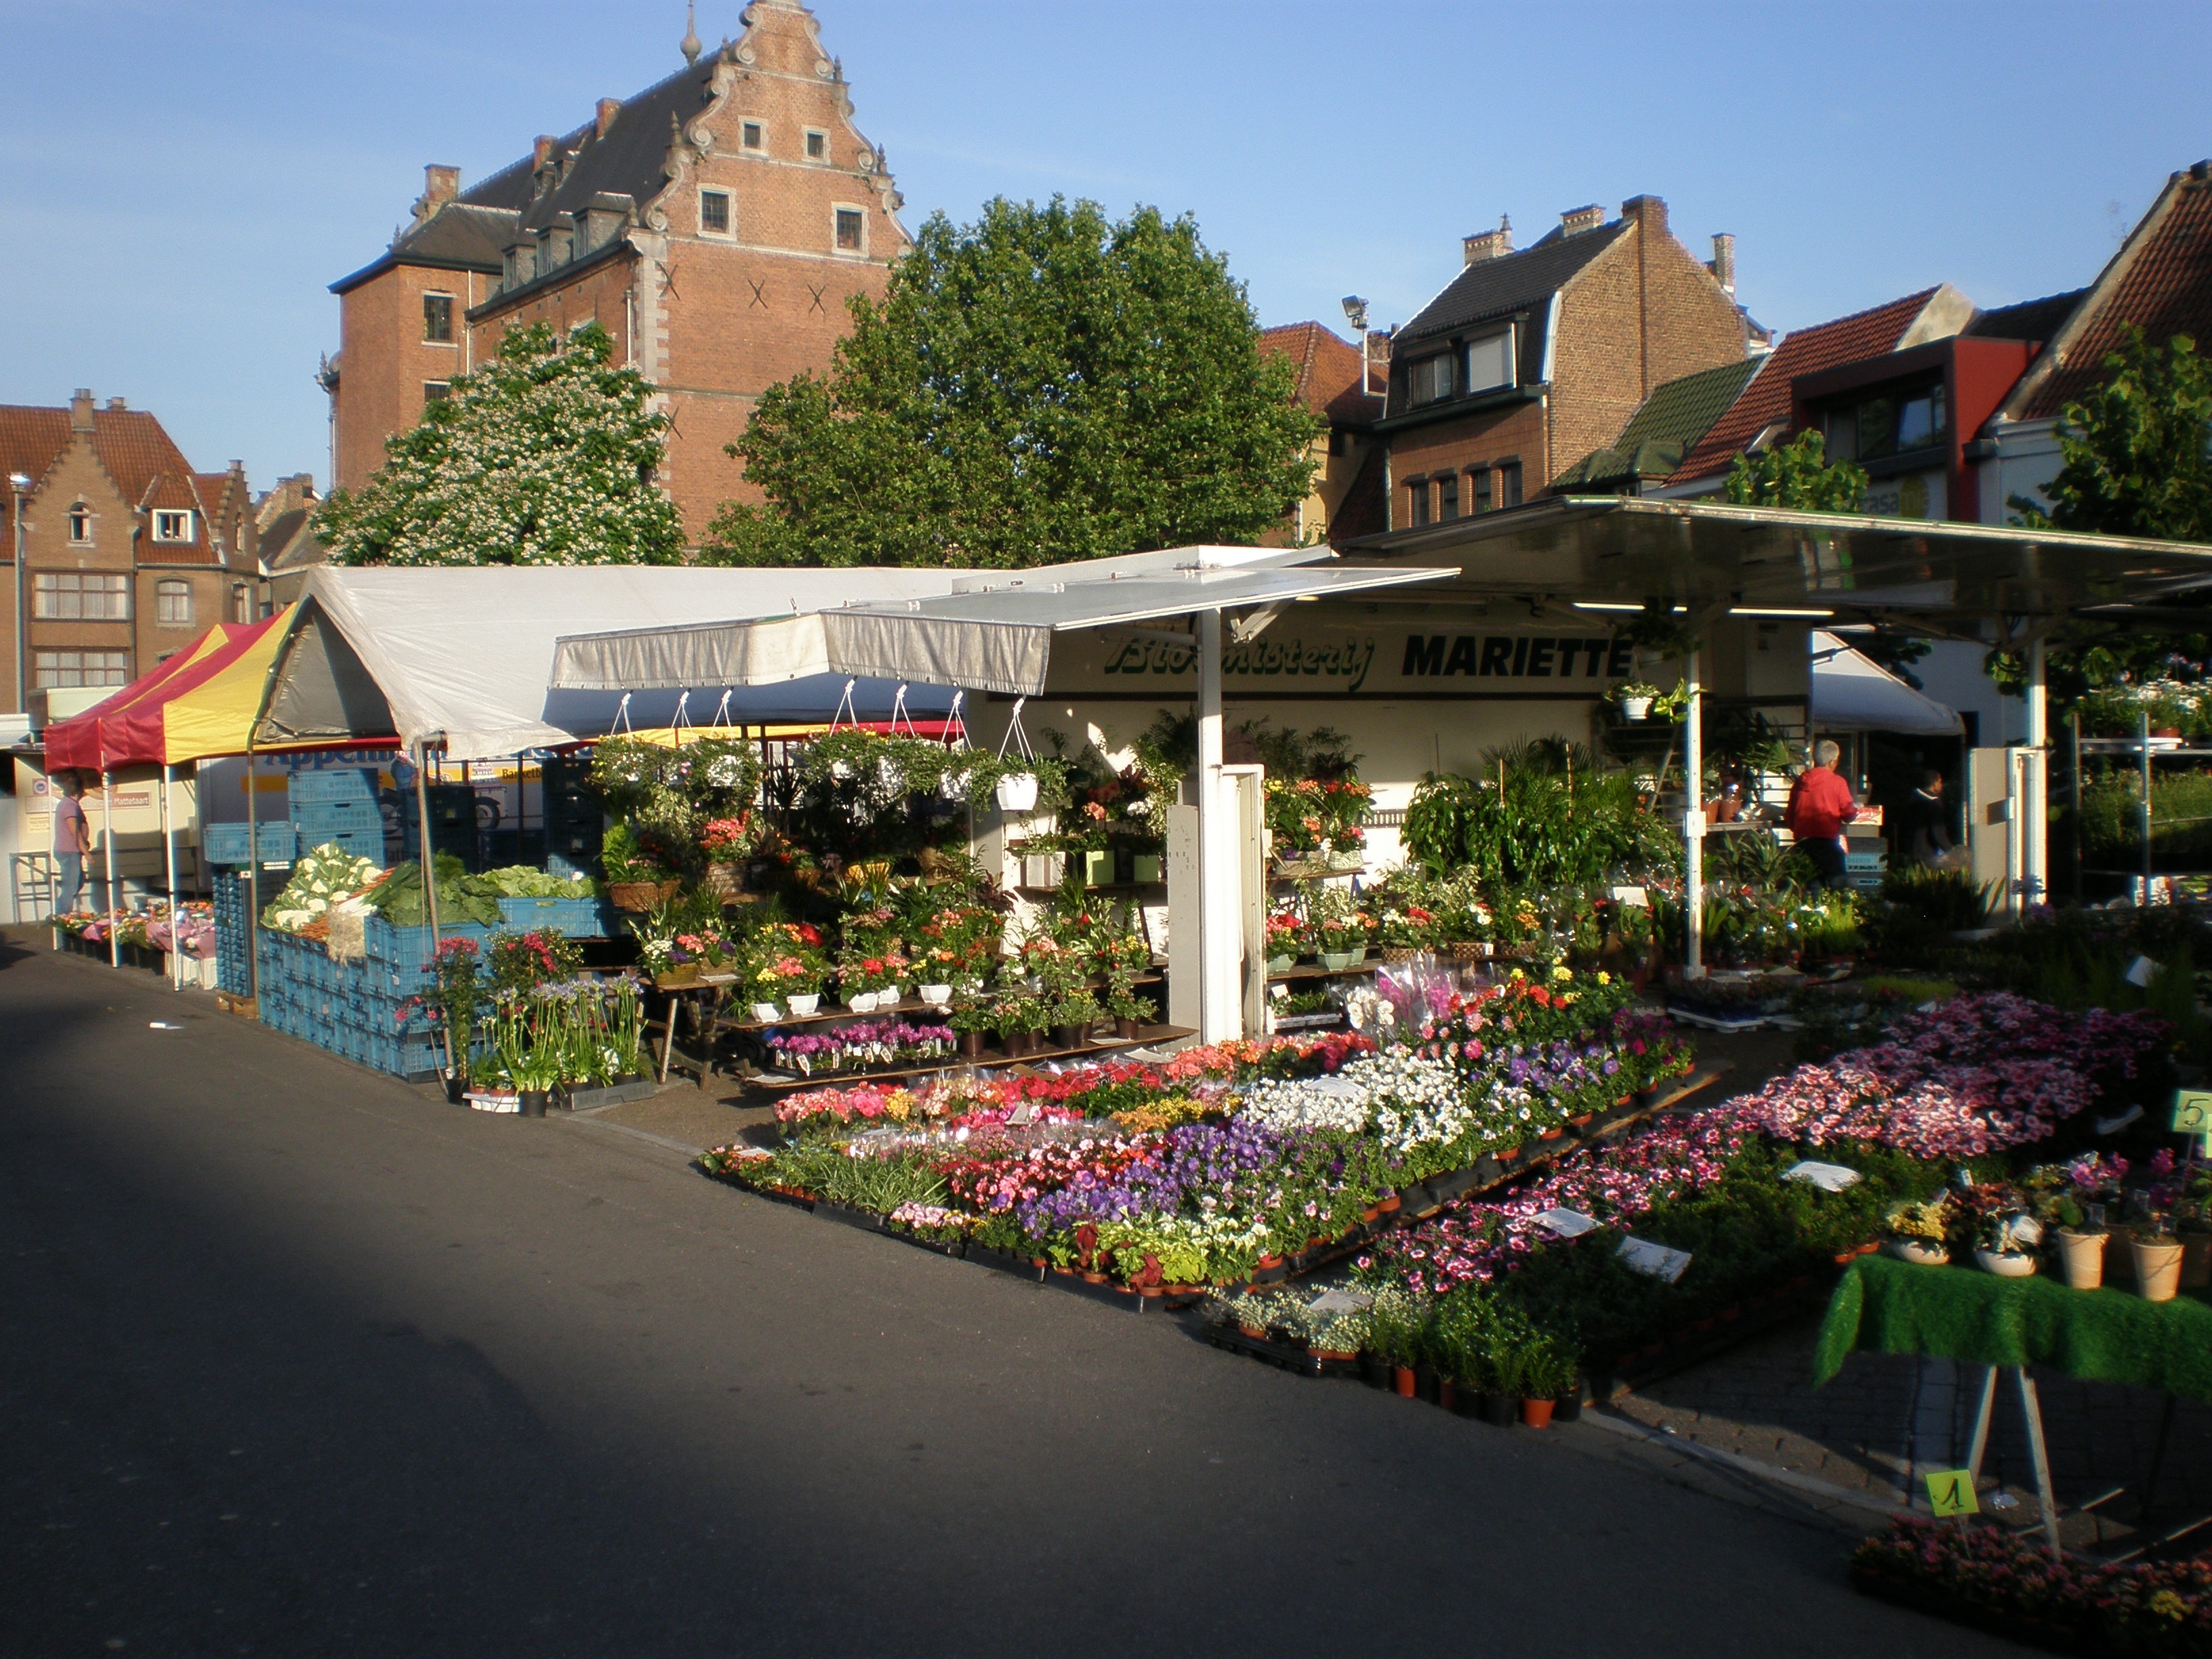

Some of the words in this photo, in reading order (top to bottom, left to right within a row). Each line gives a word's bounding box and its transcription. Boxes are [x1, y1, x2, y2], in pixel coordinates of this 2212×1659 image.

[1104, 634, 1375, 693] Blomisterij
[1401, 635, 1635, 678] MARIETTE
[2184, 1099, 2210, 1126] 5
